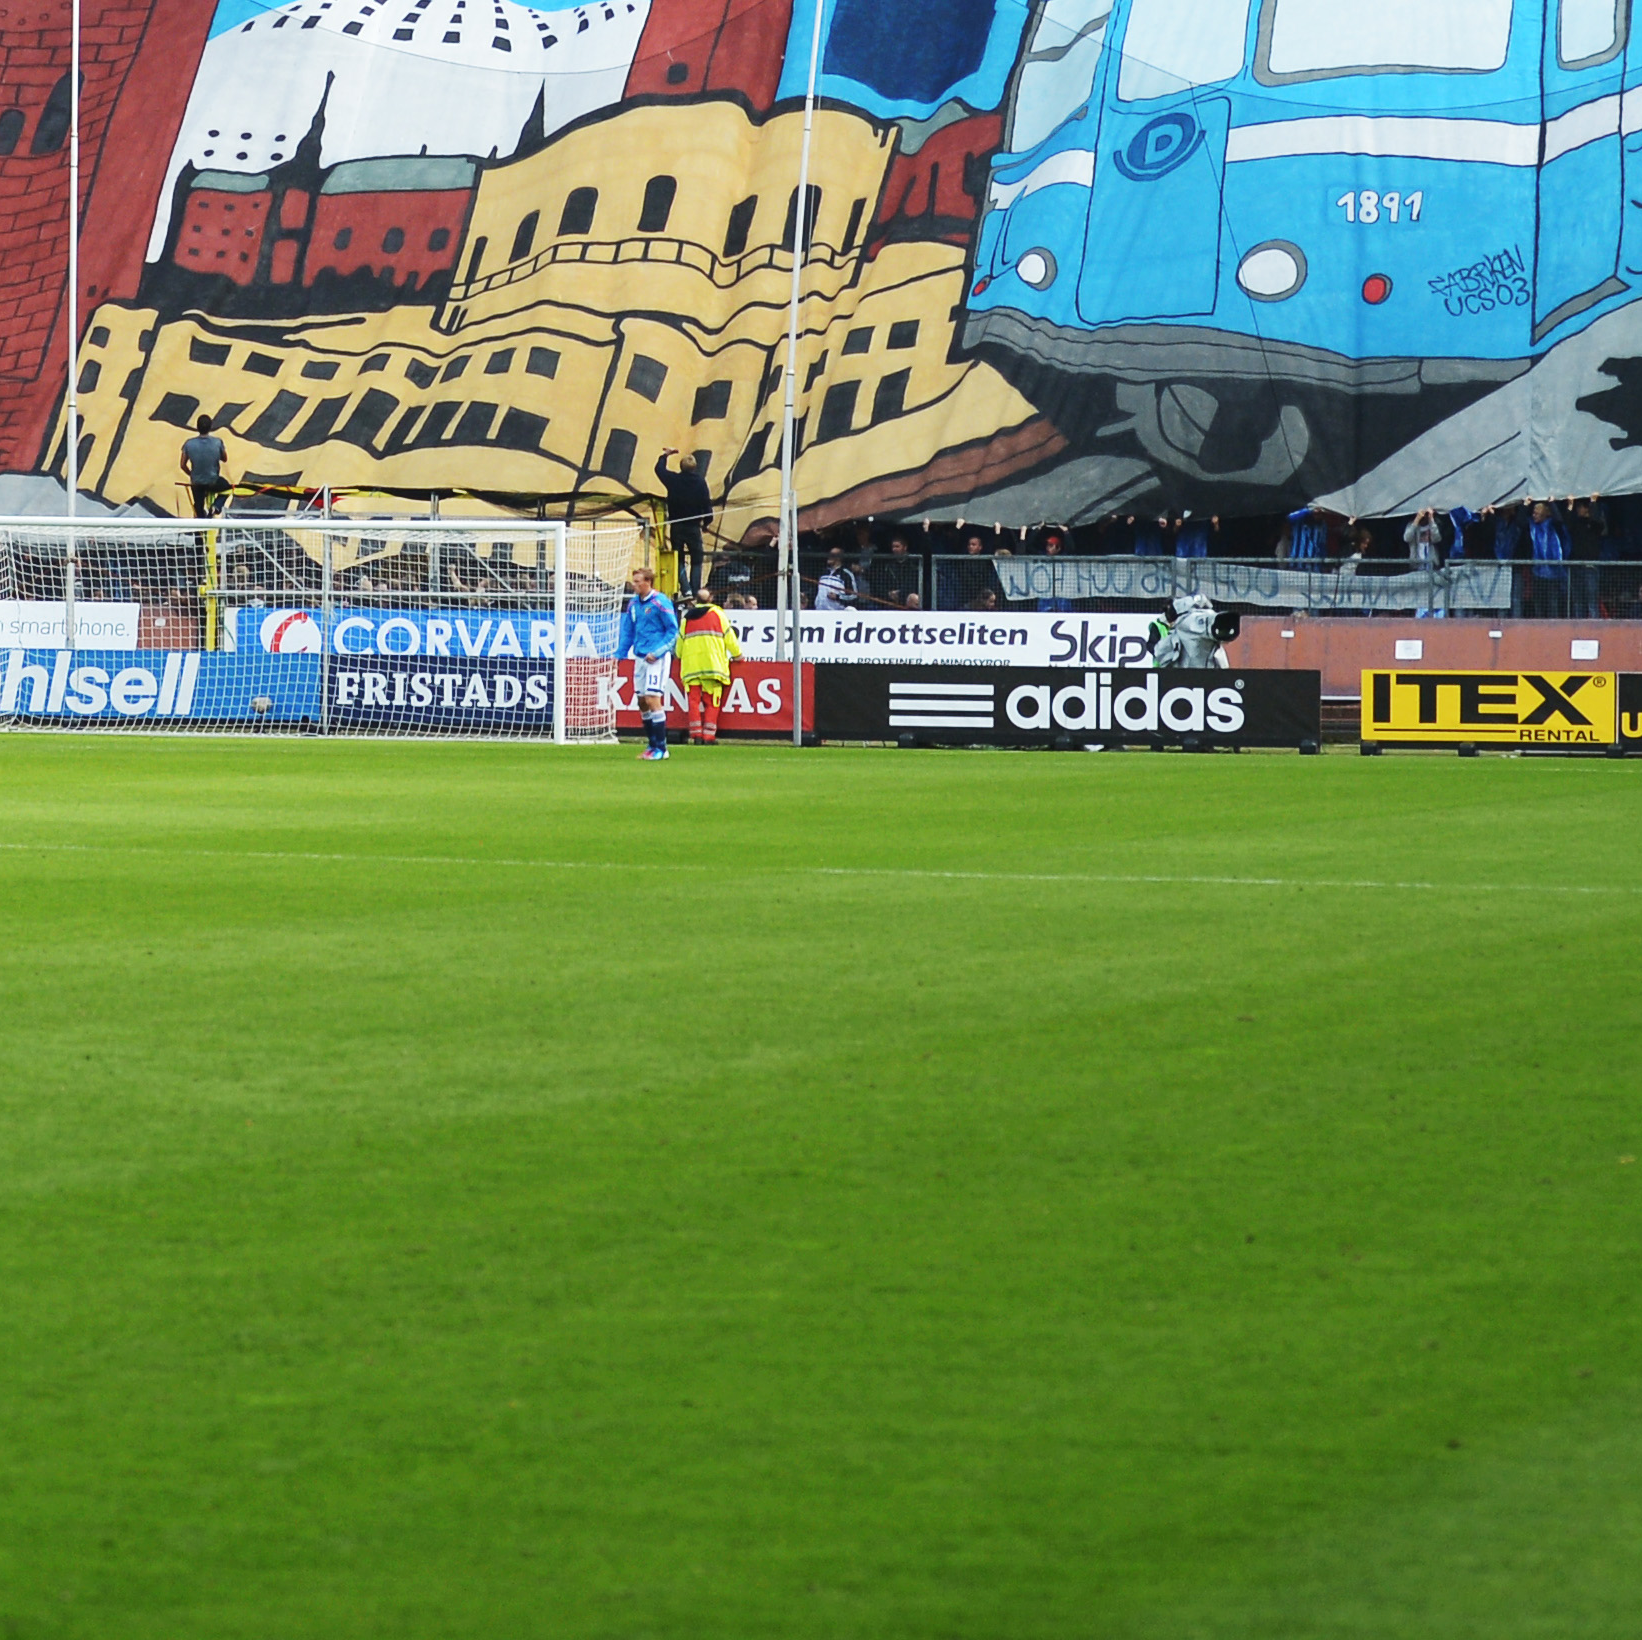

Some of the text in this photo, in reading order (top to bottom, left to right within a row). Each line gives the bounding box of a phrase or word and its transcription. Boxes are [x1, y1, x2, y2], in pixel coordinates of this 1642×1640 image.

[1336, 189, 1423, 223] 1891
[9, 617, 130, 637] smarthone.
[333, 617, 599, 658] CORVARA
[833, 621, 1028, 646] idrottseliten
[335, 672, 548, 710] FRISTADS
[595, 675, 782, 715] KNAS
[1005, 672, 1245, 733] adidas
[1372, 673, 1594, 726] ITEX
[1519, 729, 1600, 742] RENTAL
